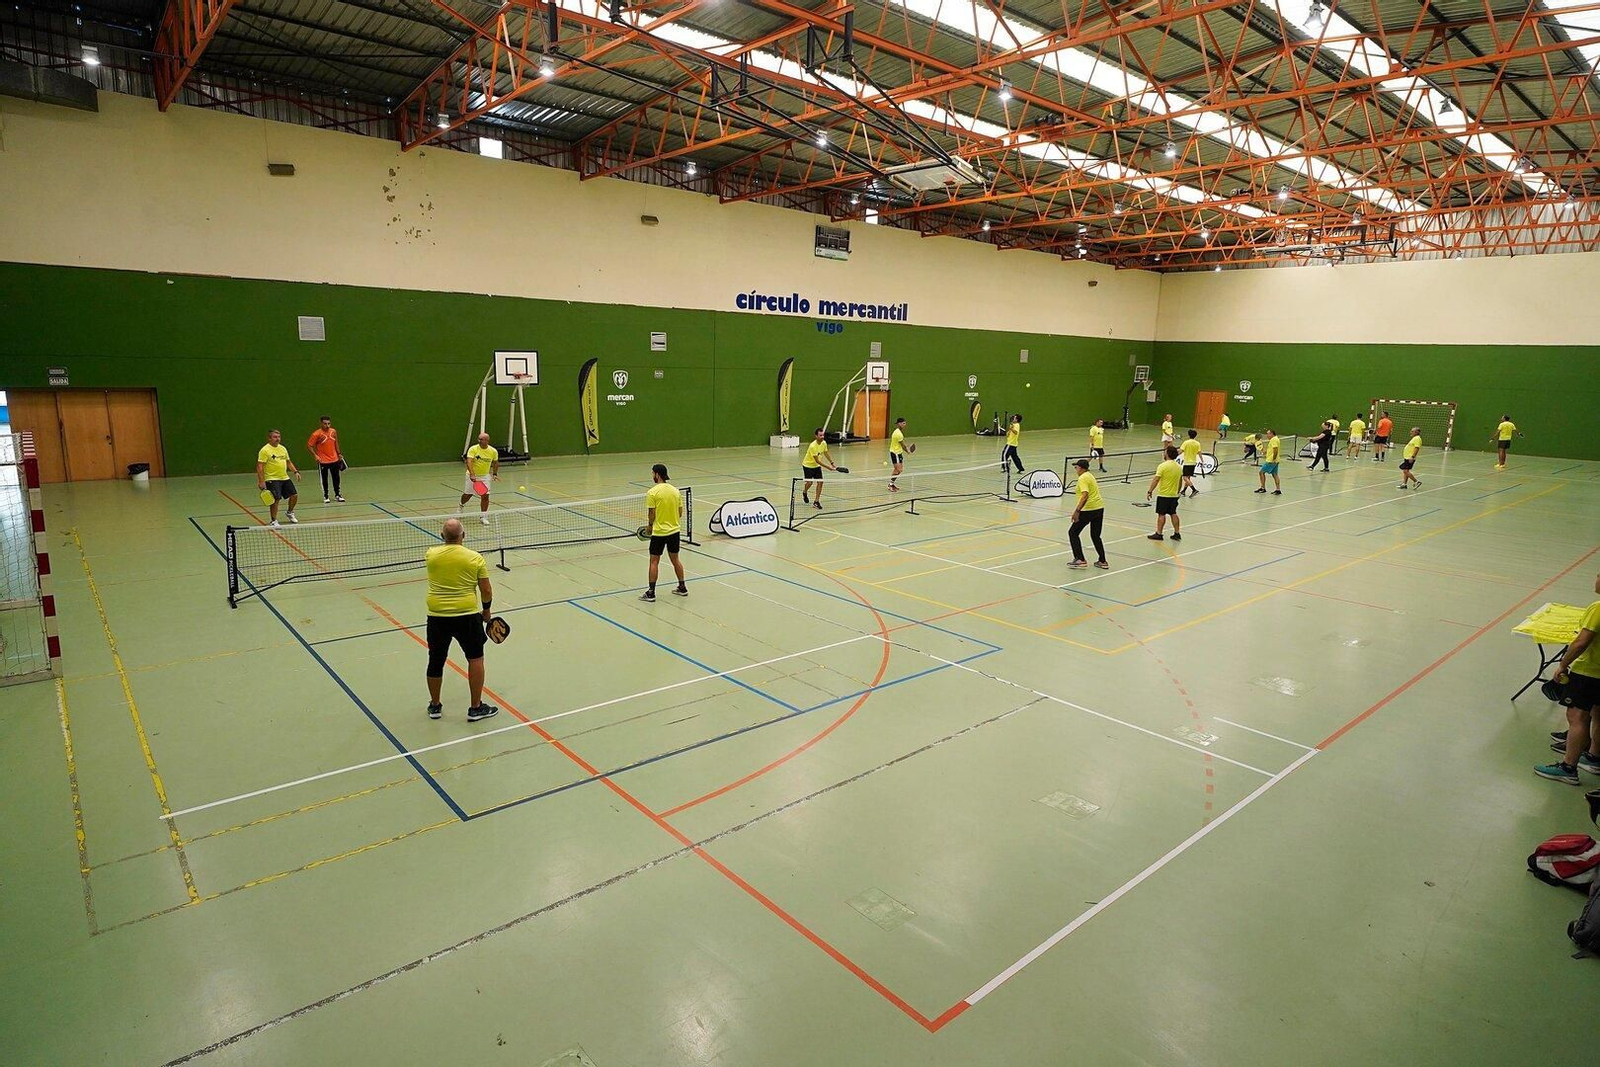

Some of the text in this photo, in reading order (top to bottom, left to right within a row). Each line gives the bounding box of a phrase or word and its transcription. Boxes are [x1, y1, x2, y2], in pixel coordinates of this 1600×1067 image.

[736, 290, 908, 321] círculo mercantil
[816, 321, 843, 334] vigo
[1032, 480, 1061, 489] Atlántico
[726, 511, 775, 527] Atlántico
